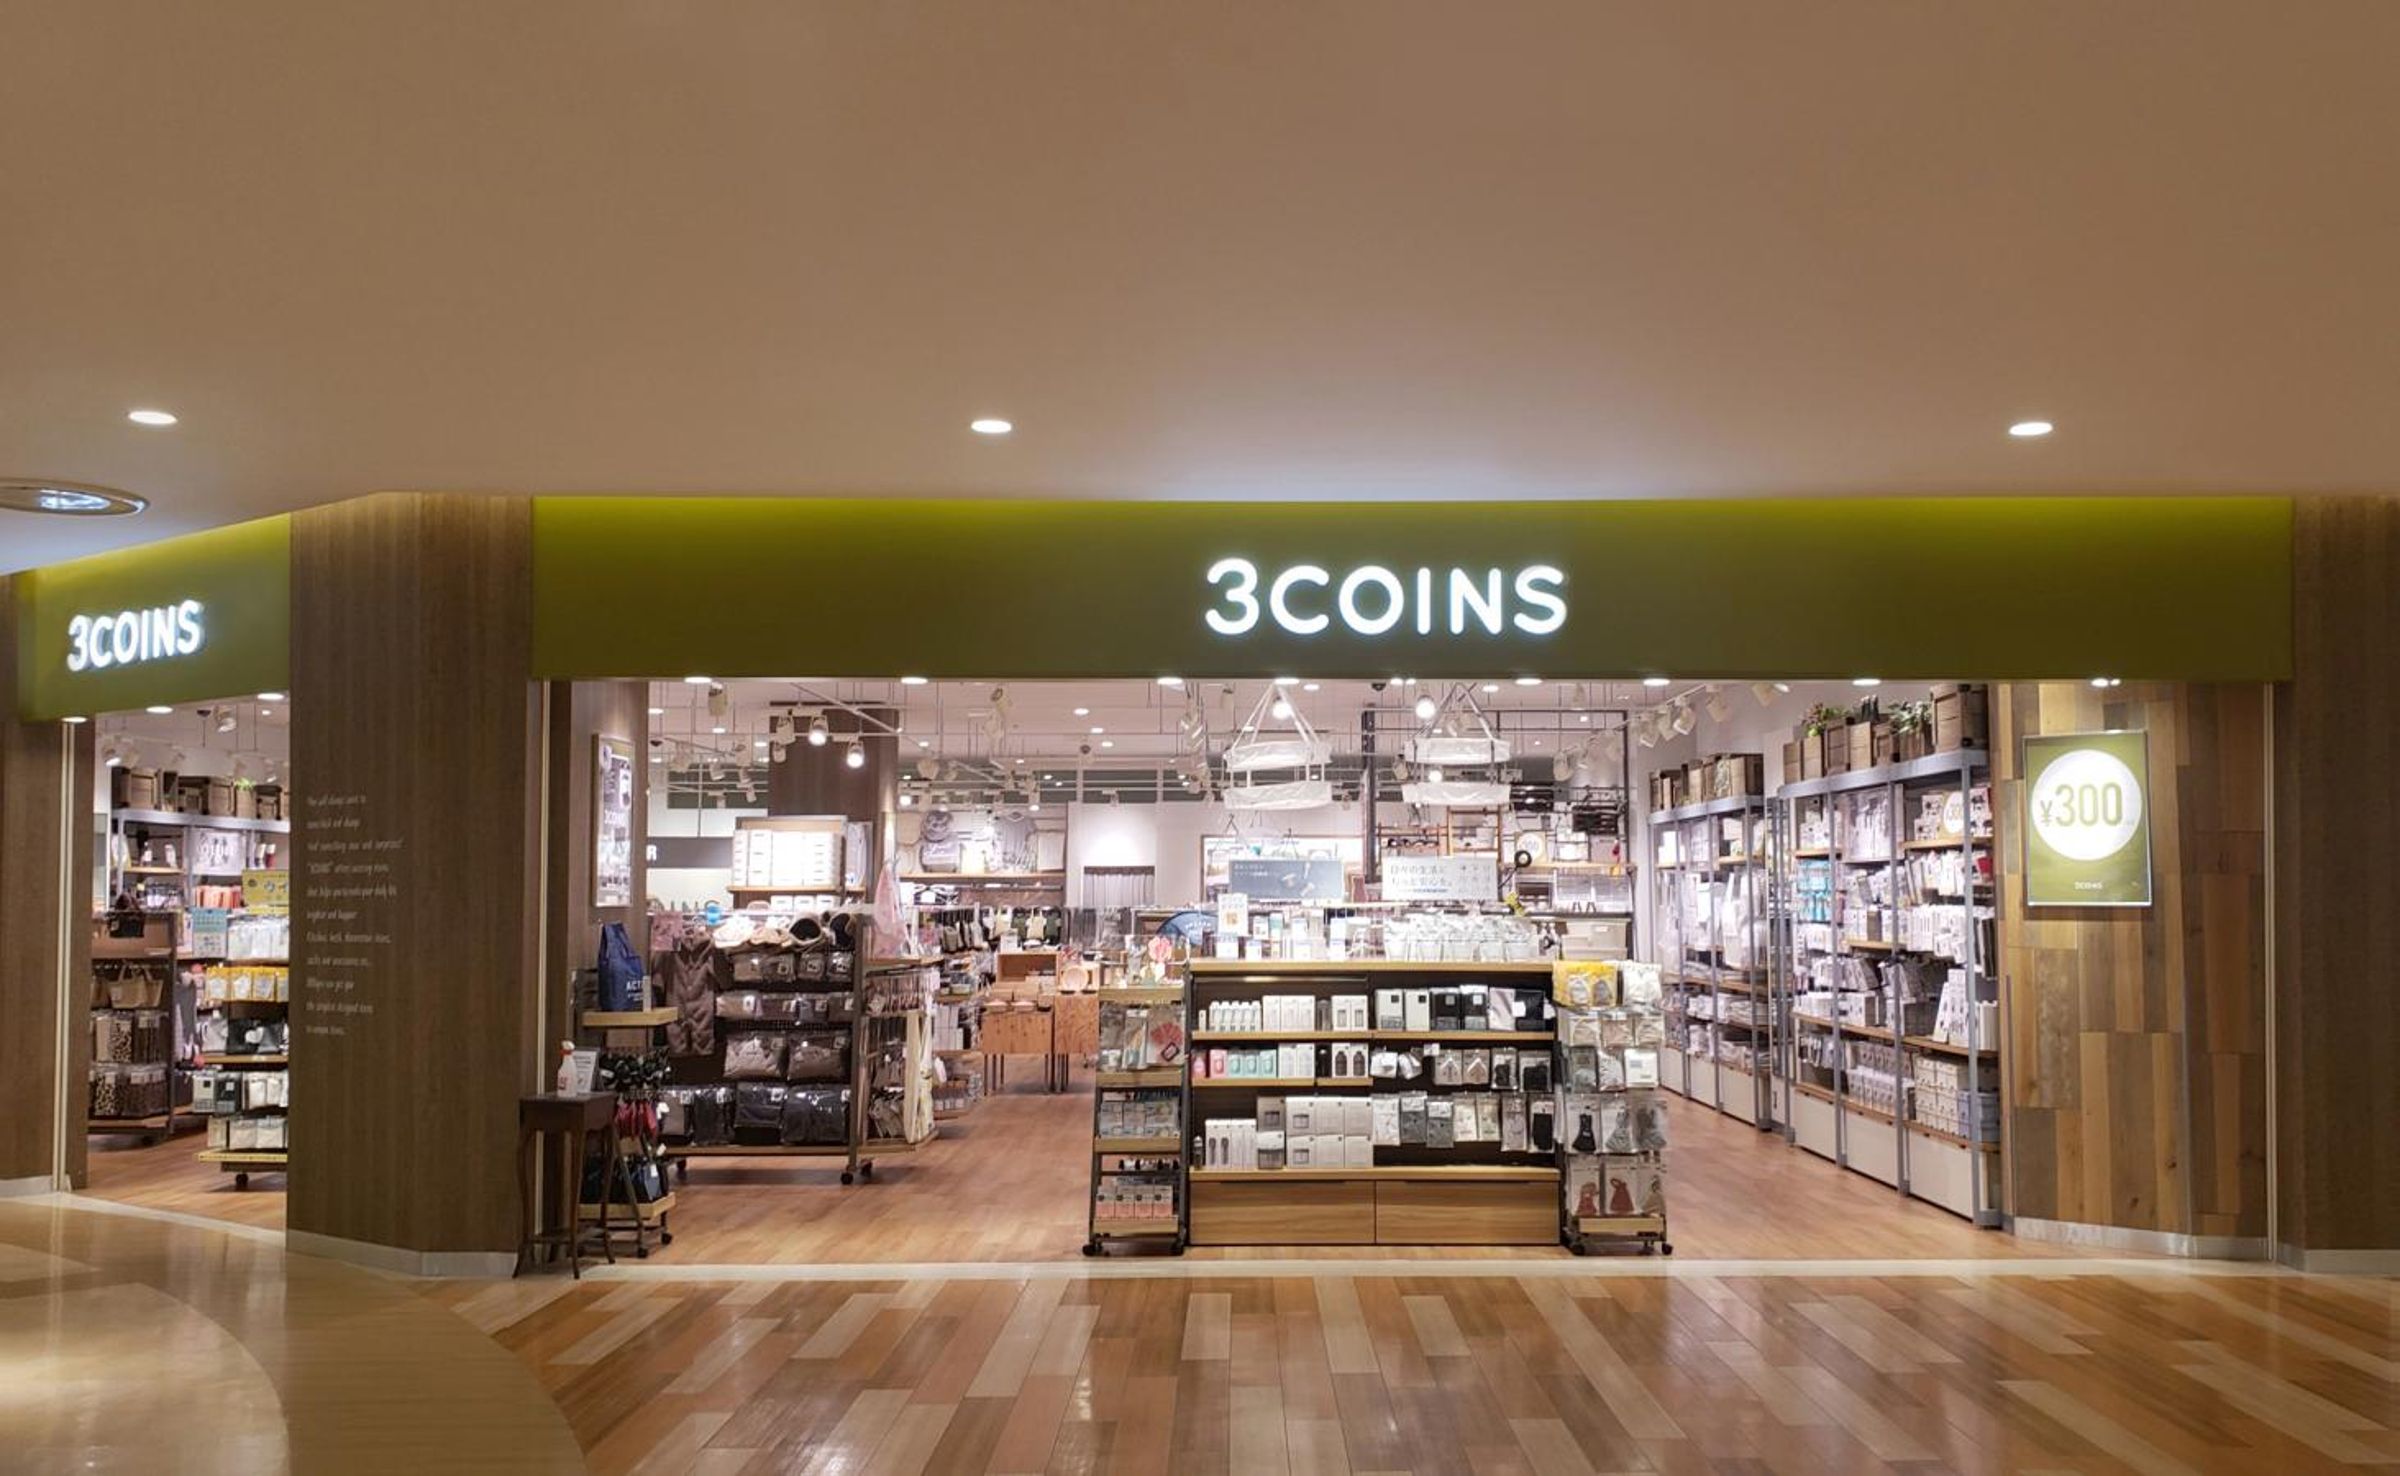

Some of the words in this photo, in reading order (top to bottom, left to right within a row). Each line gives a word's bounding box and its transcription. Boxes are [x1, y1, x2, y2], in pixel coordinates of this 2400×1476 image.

[1205, 557, 1569, 635] 3COINS
[67, 599, 204, 672] 3COINS
[2040, 781, 2123, 827] ¥300
